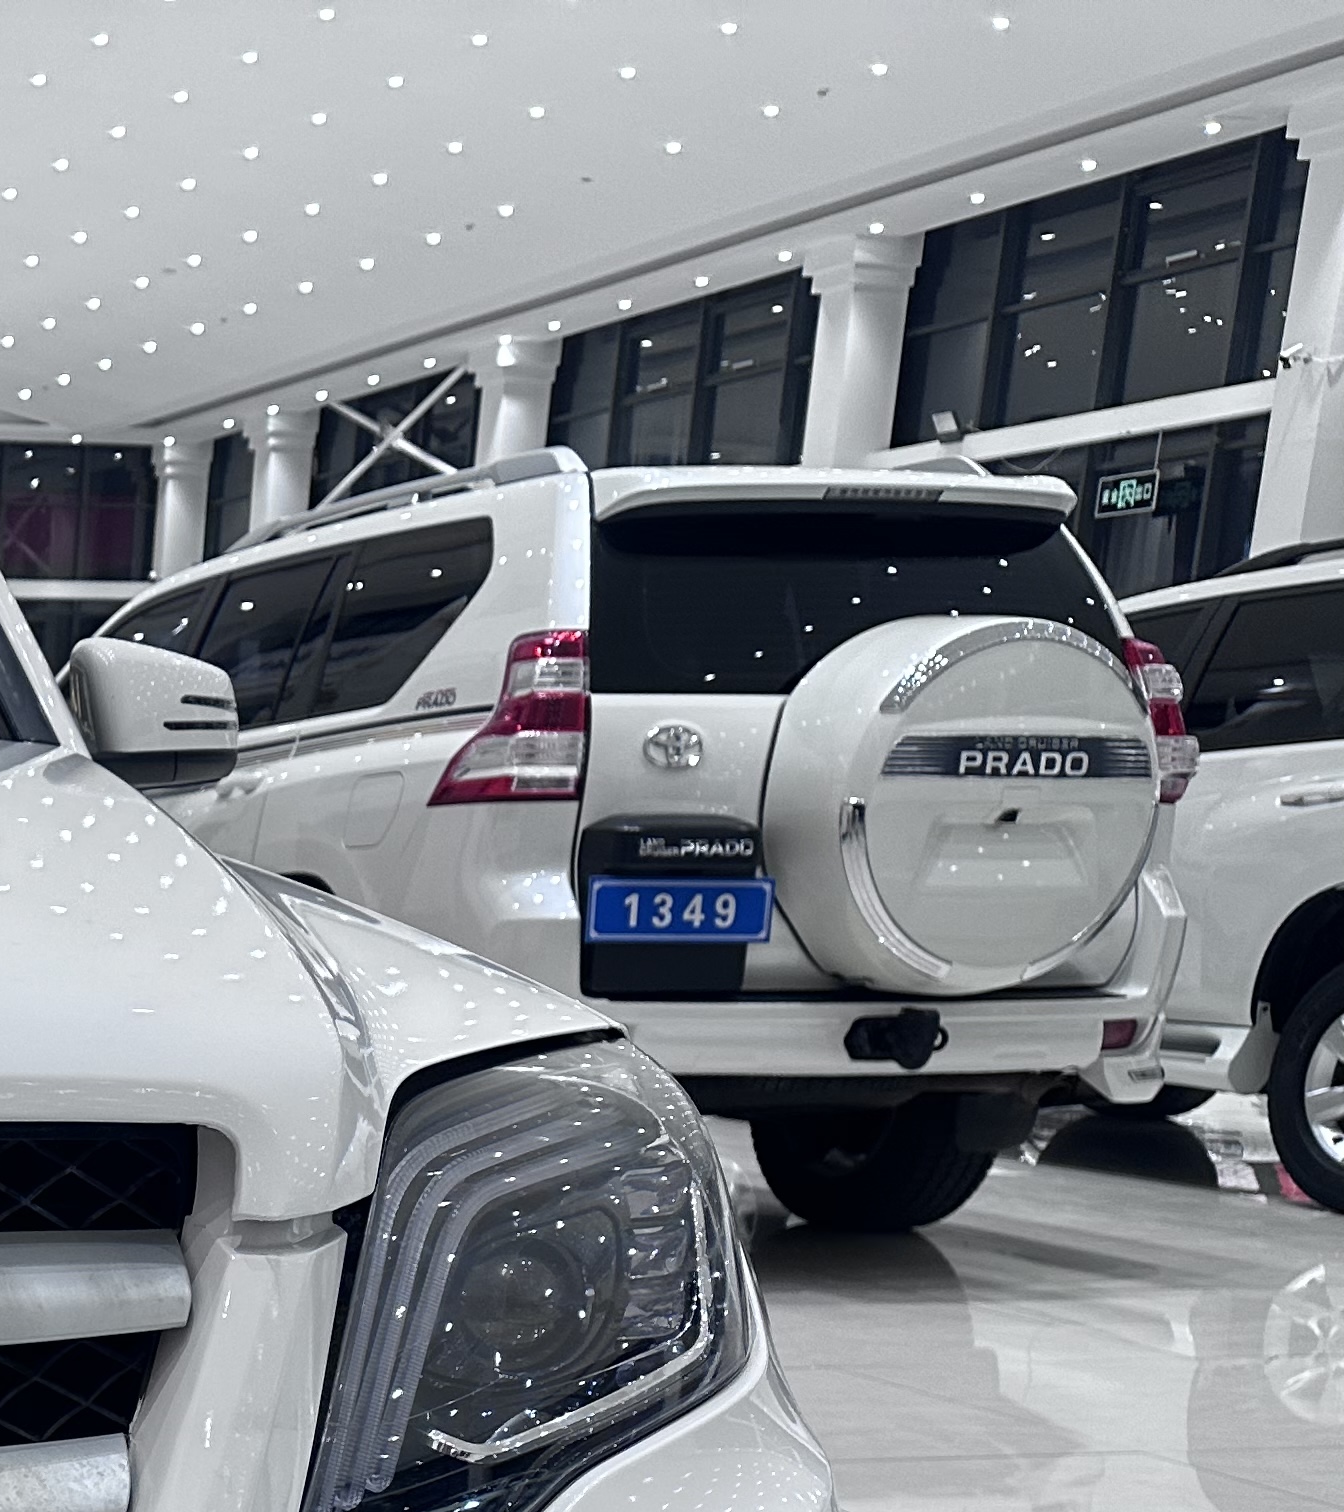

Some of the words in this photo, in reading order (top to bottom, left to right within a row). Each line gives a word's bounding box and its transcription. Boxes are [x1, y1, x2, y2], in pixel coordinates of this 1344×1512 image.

[958, 750, 1090, 777] PRADO
[680, 838, 754, 857] PRADO
[624, 892, 737, 928] 1349
